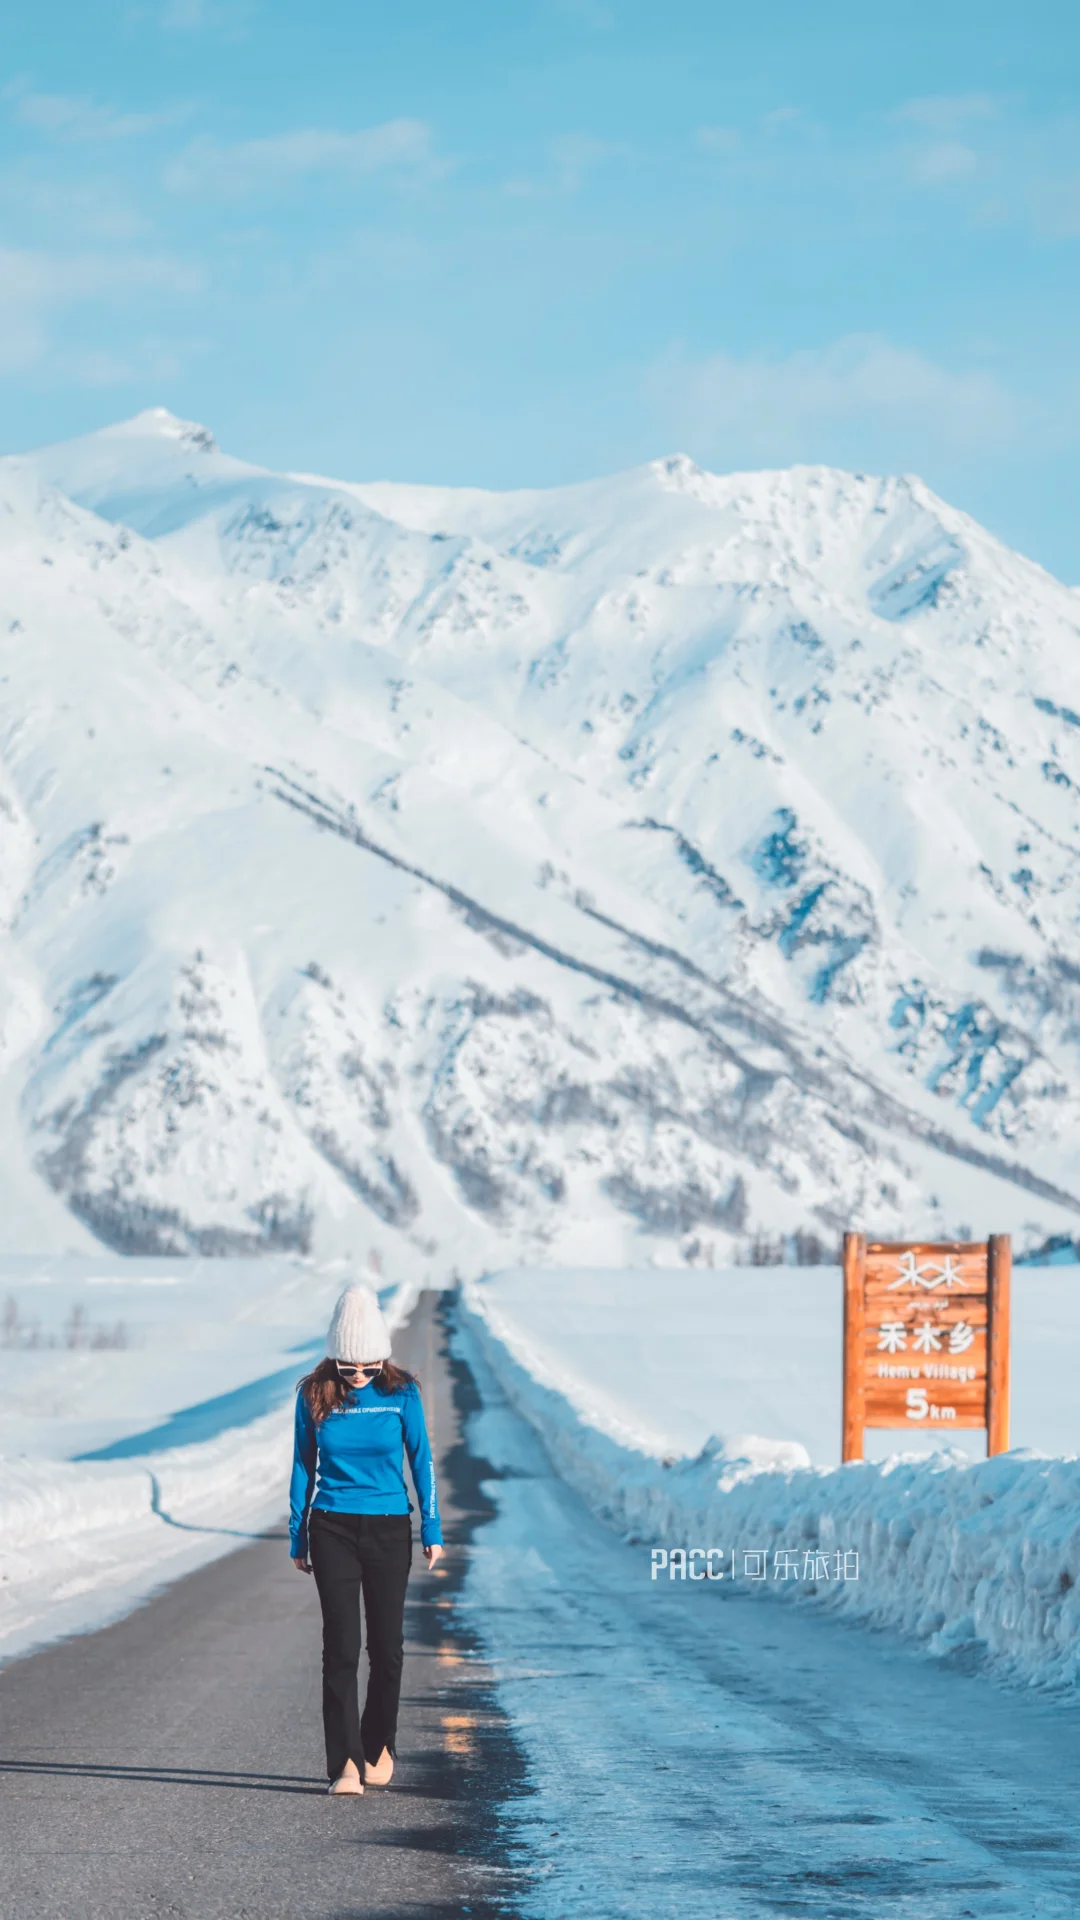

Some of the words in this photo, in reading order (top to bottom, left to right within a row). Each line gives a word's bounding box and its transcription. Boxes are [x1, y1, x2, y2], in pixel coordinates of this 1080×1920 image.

[877, 1321, 975, 1355] 禾木乡
[878, 1363, 920, 1379] Hemu
[924, 1363, 977, 1383] Village
